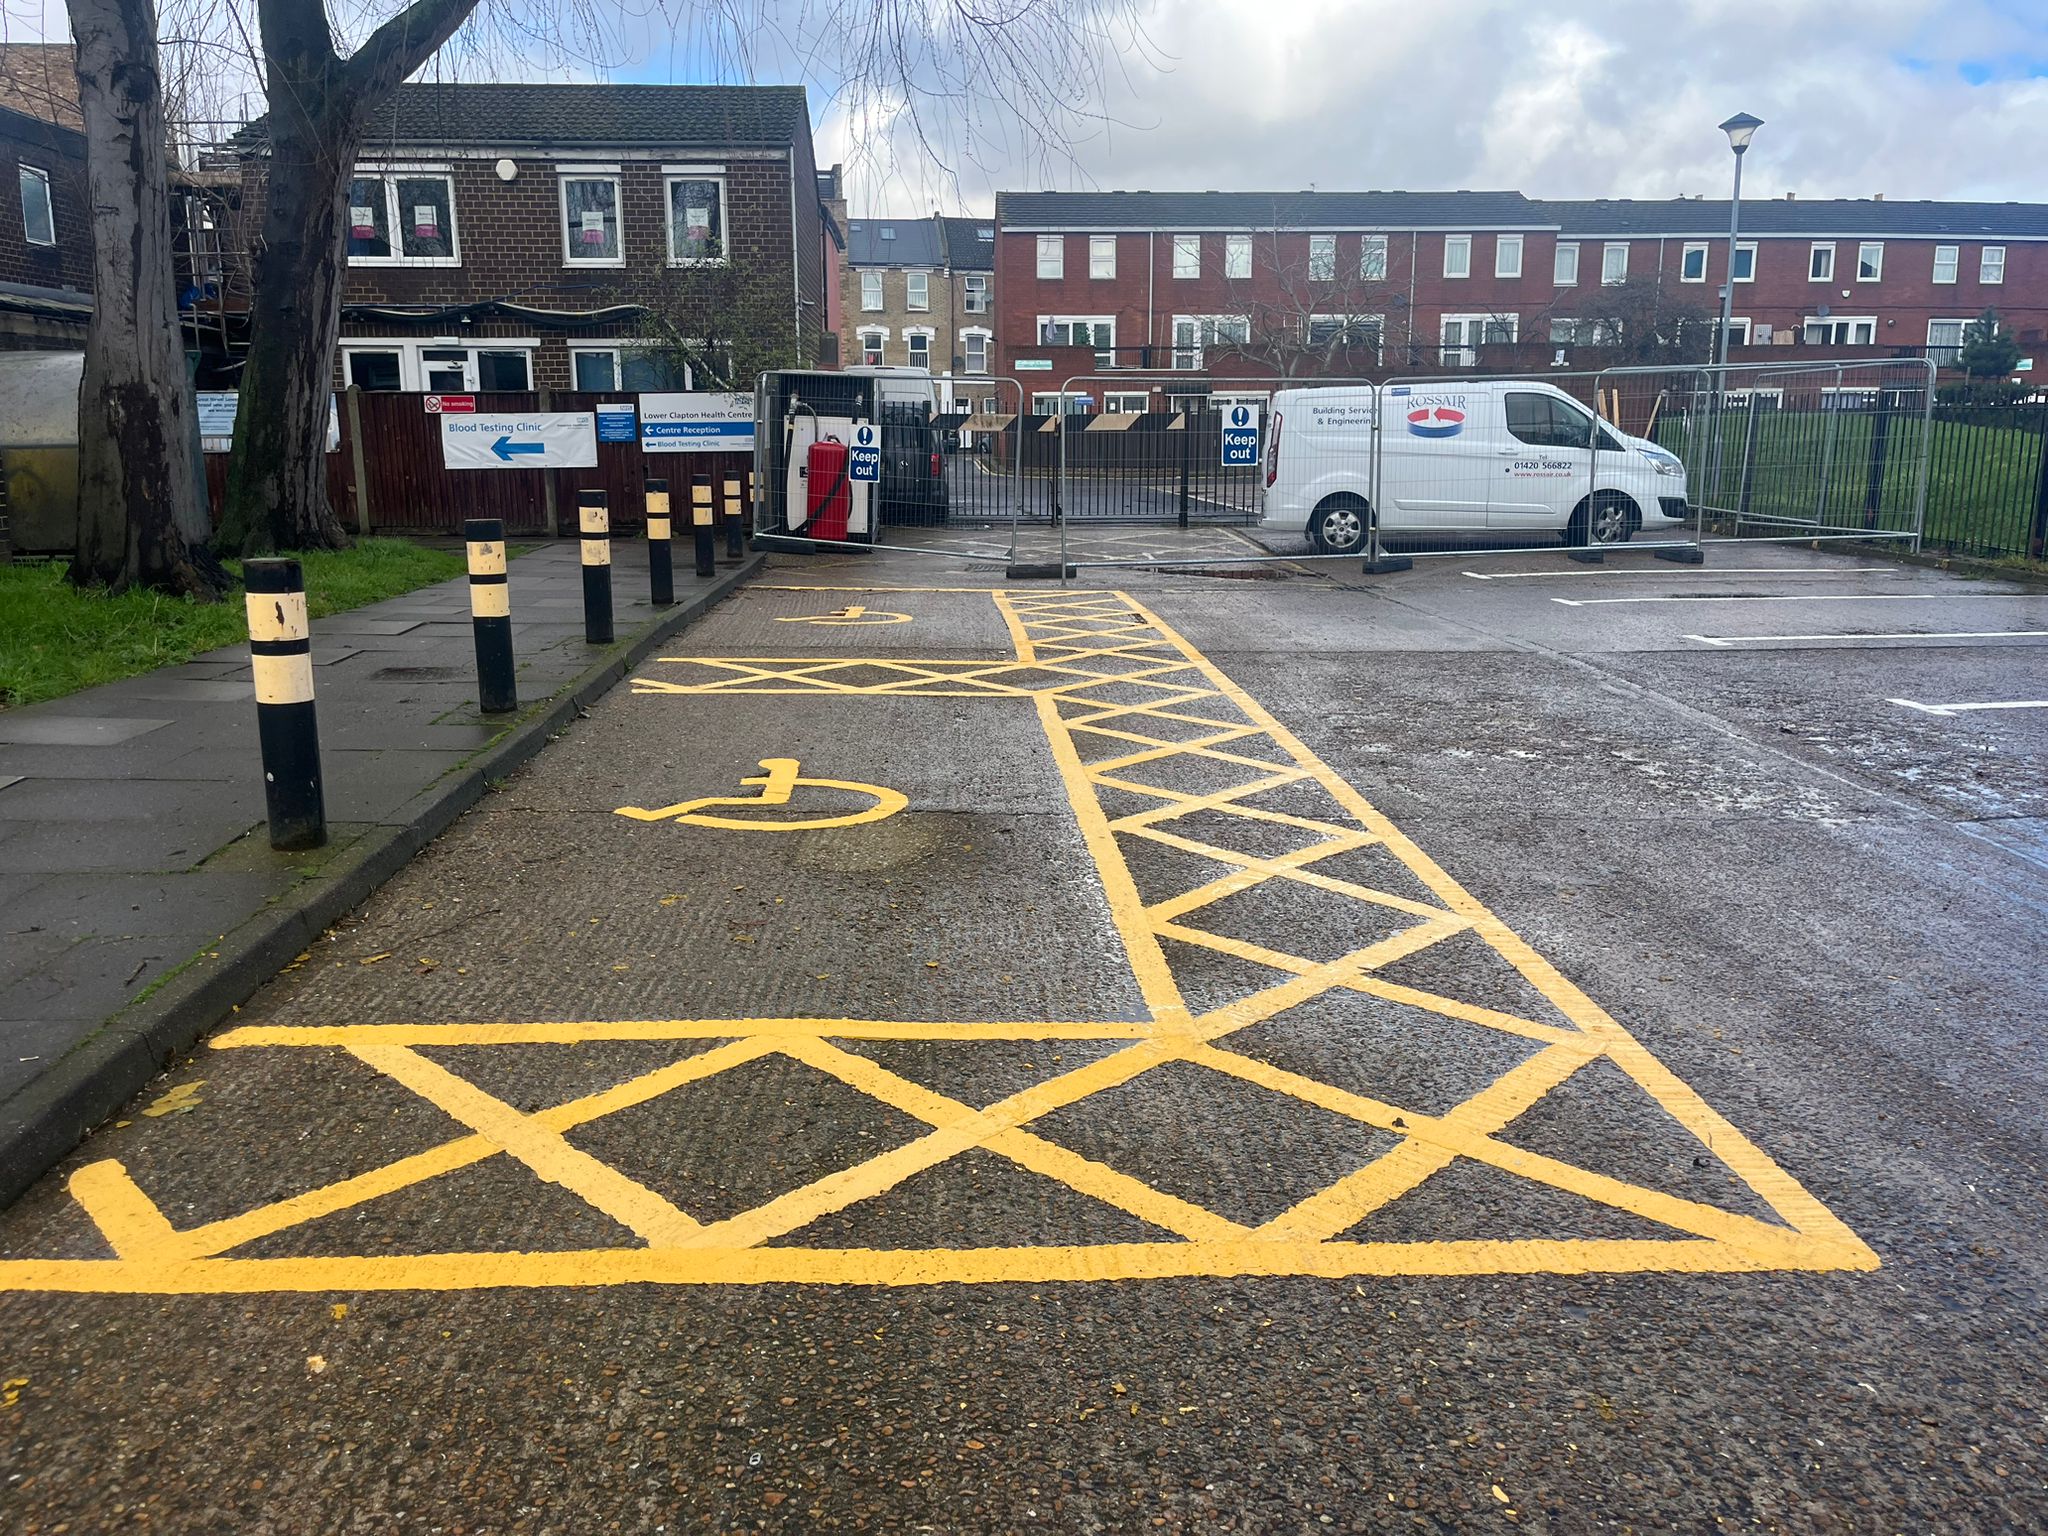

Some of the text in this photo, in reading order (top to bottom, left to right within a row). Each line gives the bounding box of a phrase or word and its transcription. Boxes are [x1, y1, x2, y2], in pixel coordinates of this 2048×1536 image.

[1407, 395, 1466, 409] ROSSAIR
[670, 412, 700, 420] Clapton
[1312, 407, 1345, 416] Building
[1328, 418, 1372, 426] Engineerin
[448, 422, 542, 434] Blood Testing Clinic
[682, 426, 720, 435] Reception
[678, 440, 701, 448] Testing
[1225, 434, 1256, 448] Keep
[852, 450, 878, 464] Keep
[1230, 448, 1250, 458] out
[856, 466, 873, 476] out
